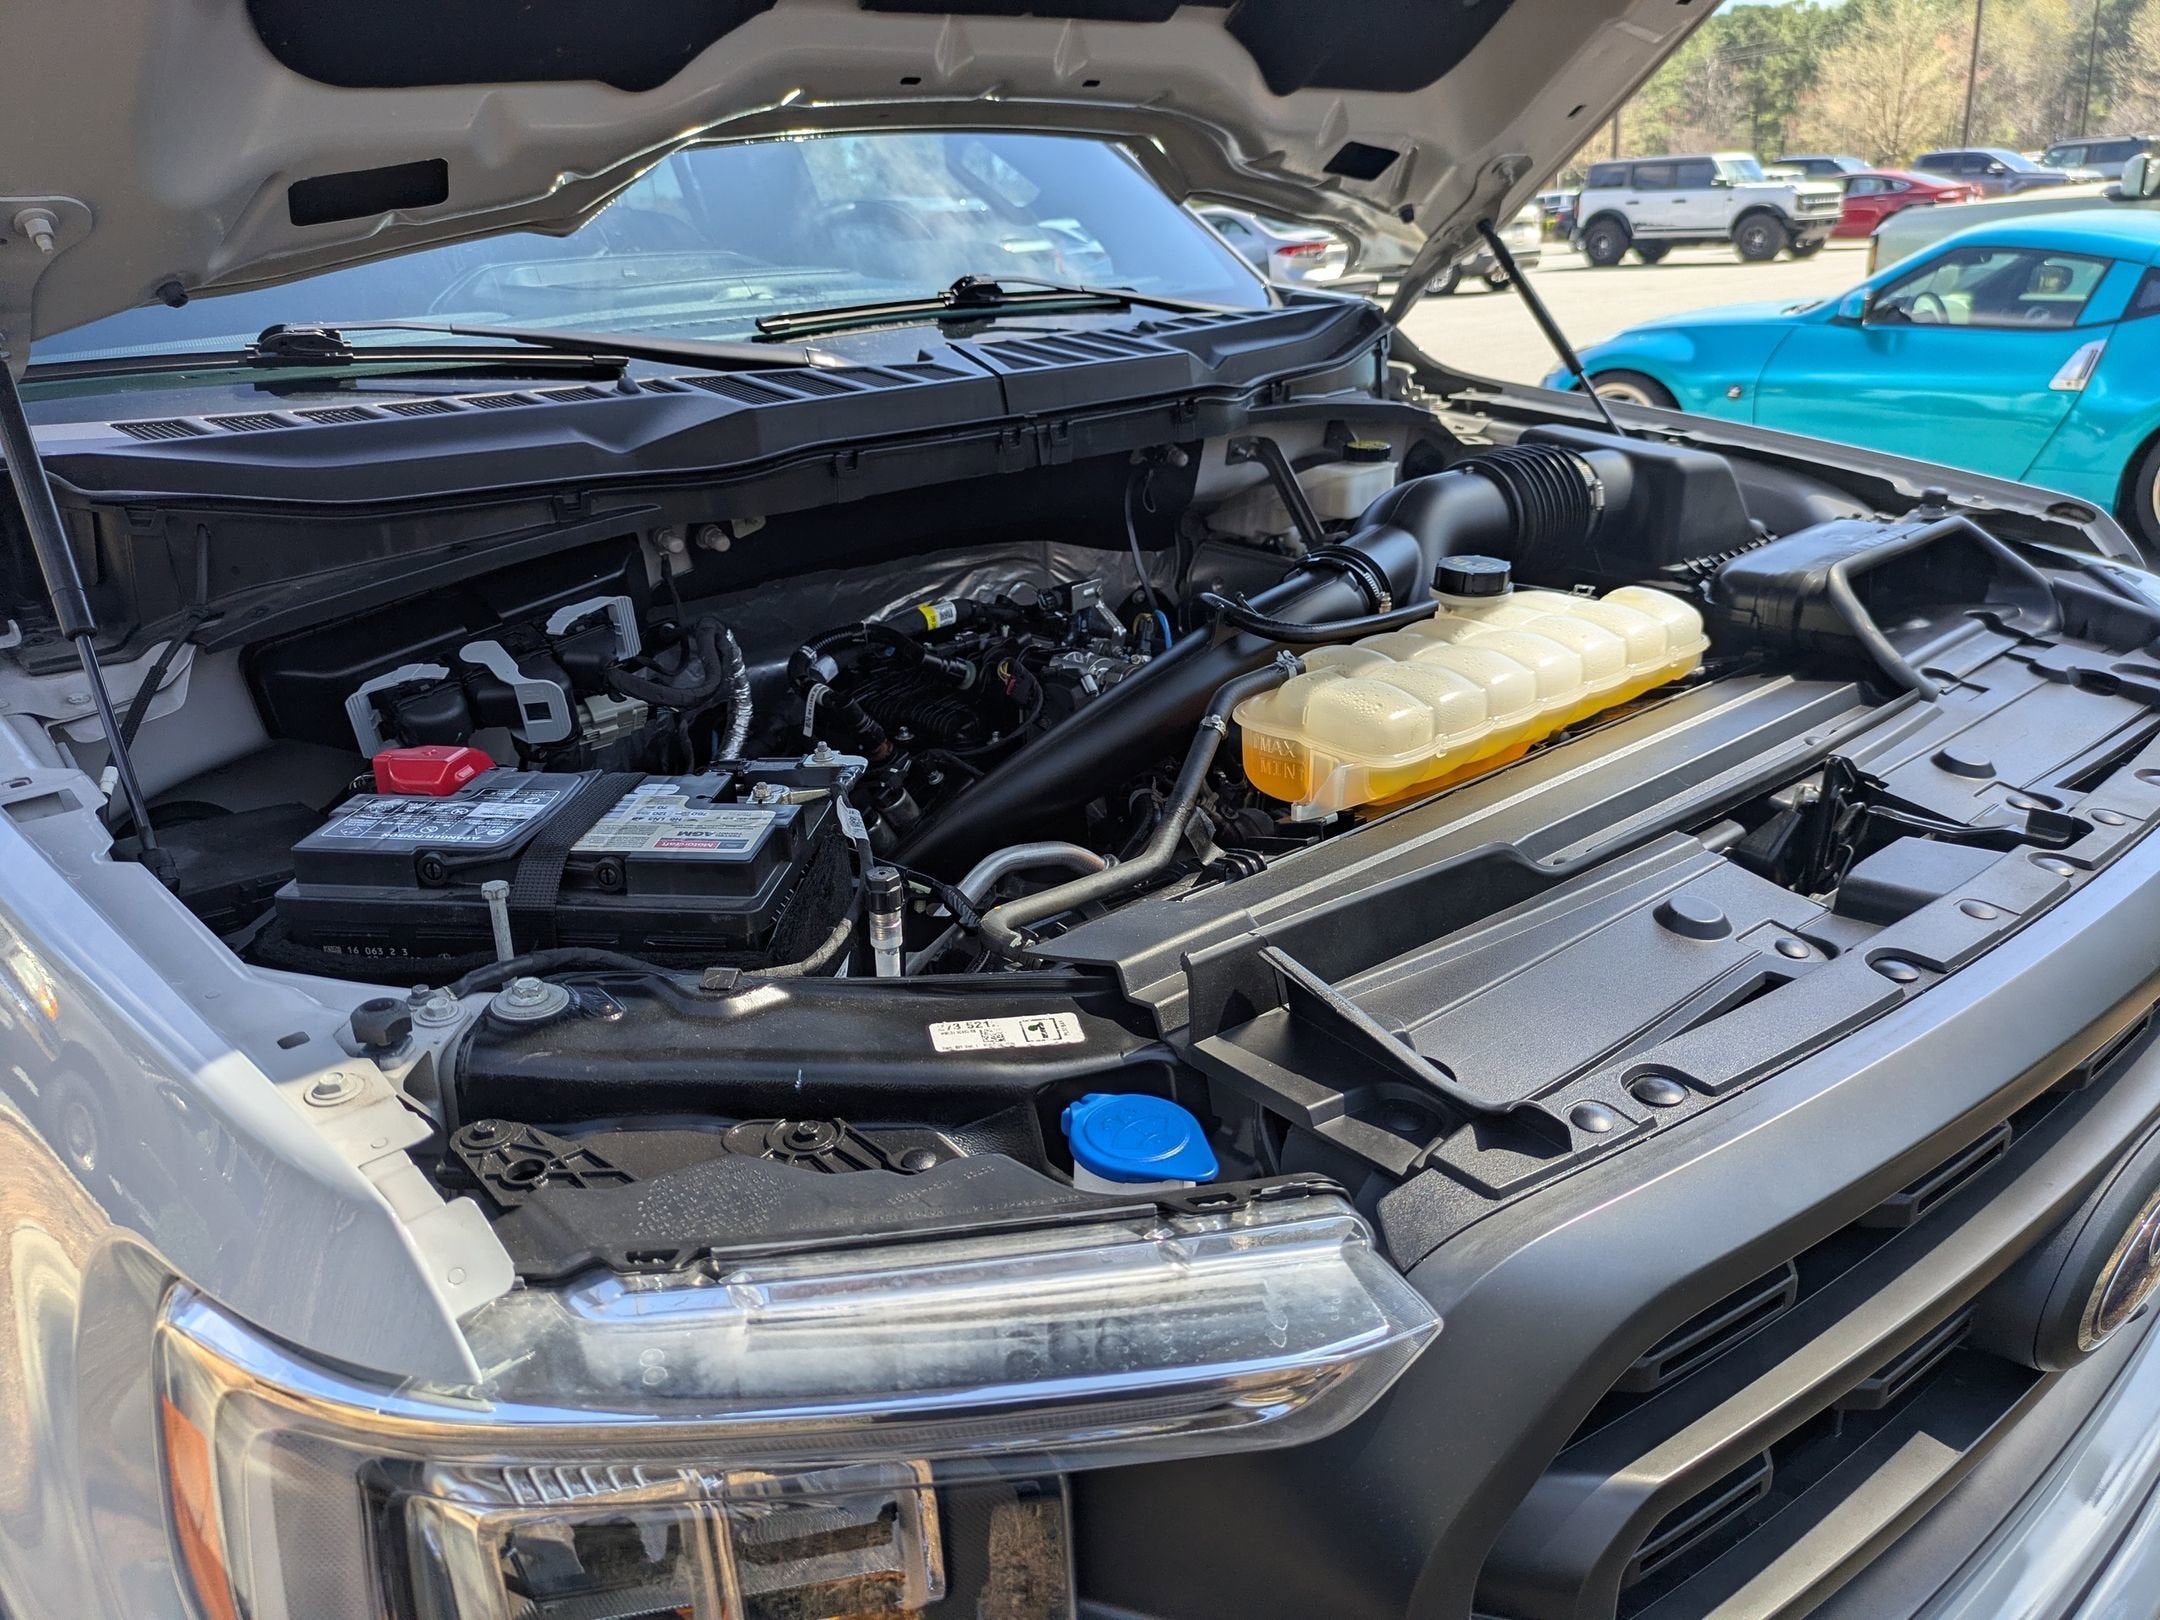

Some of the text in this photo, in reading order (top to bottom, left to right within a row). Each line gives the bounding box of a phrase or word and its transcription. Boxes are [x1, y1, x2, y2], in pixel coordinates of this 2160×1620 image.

[1260, 735, 1297, 758] MAX
[1260, 758, 1296, 779] MIN
[364, 947, 384, 955] 063
